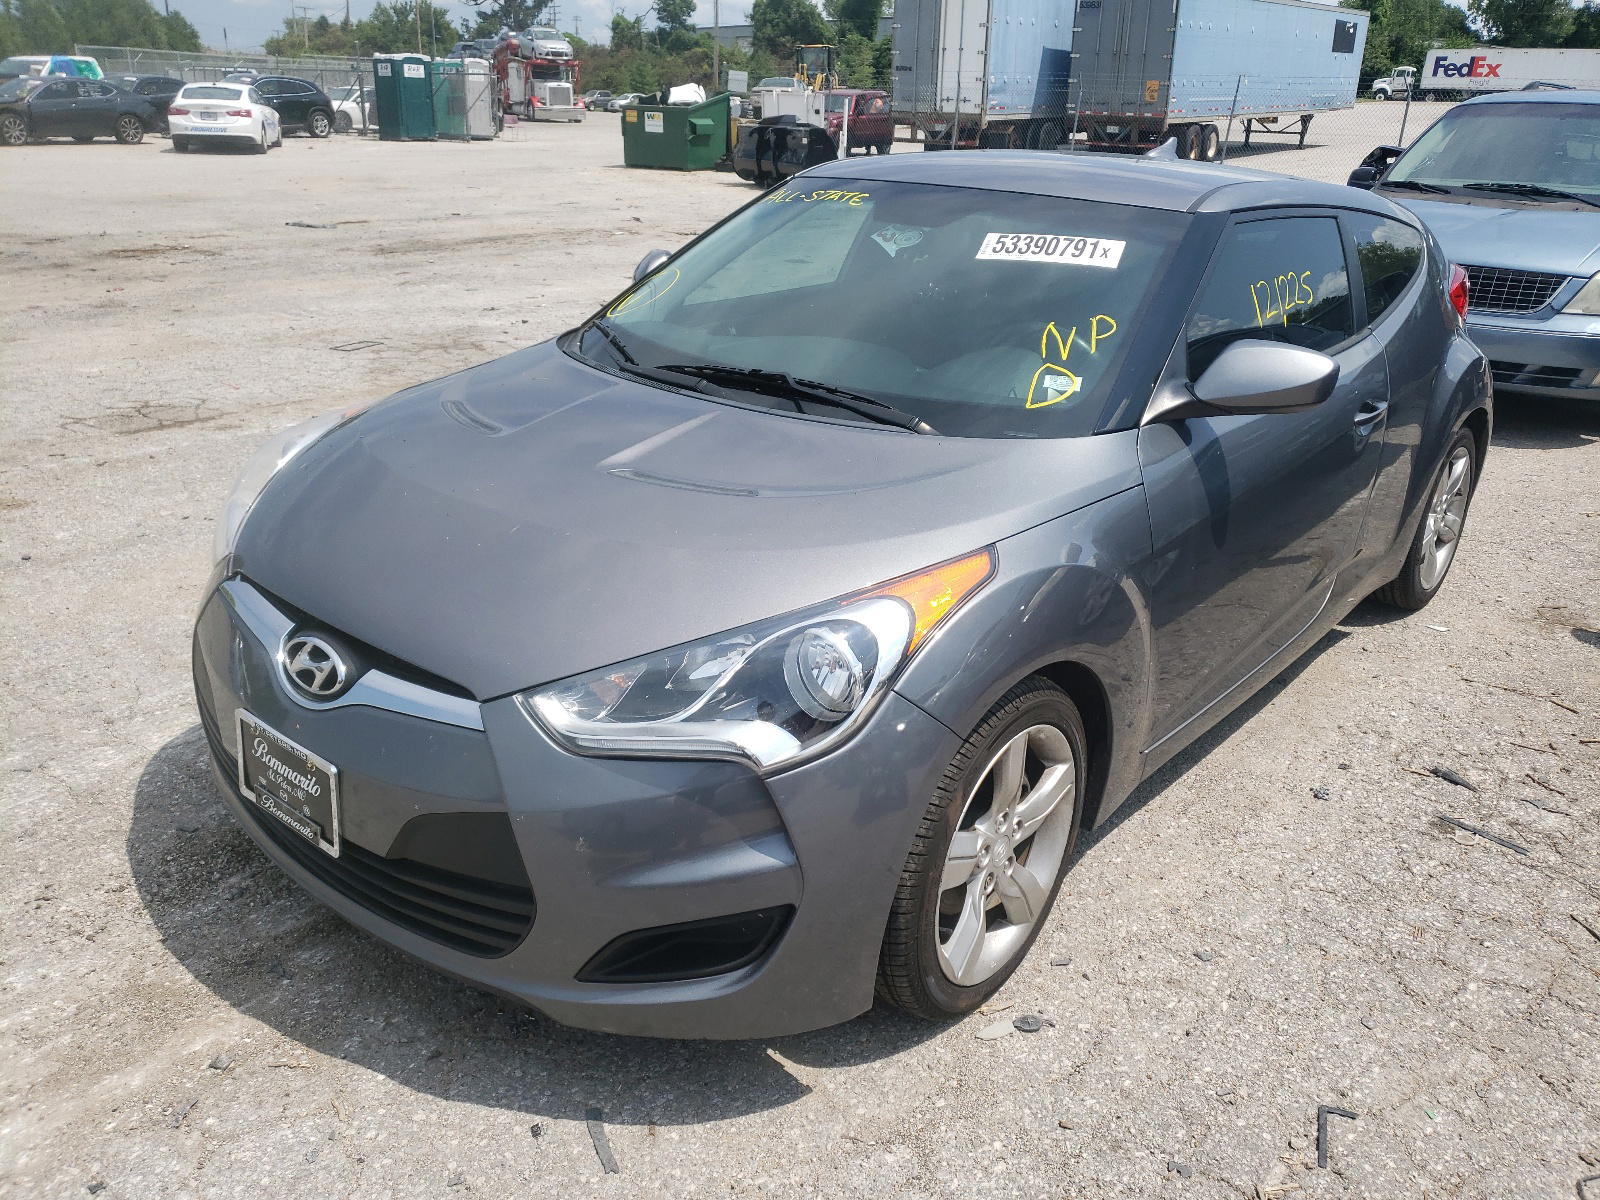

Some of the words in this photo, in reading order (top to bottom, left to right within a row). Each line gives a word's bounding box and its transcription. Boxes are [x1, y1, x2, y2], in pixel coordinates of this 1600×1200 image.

[1432, 56, 1503, 78] FedEx
[252, 737, 321, 797] Bommarito
[261, 794, 315, 839] Bommarito
